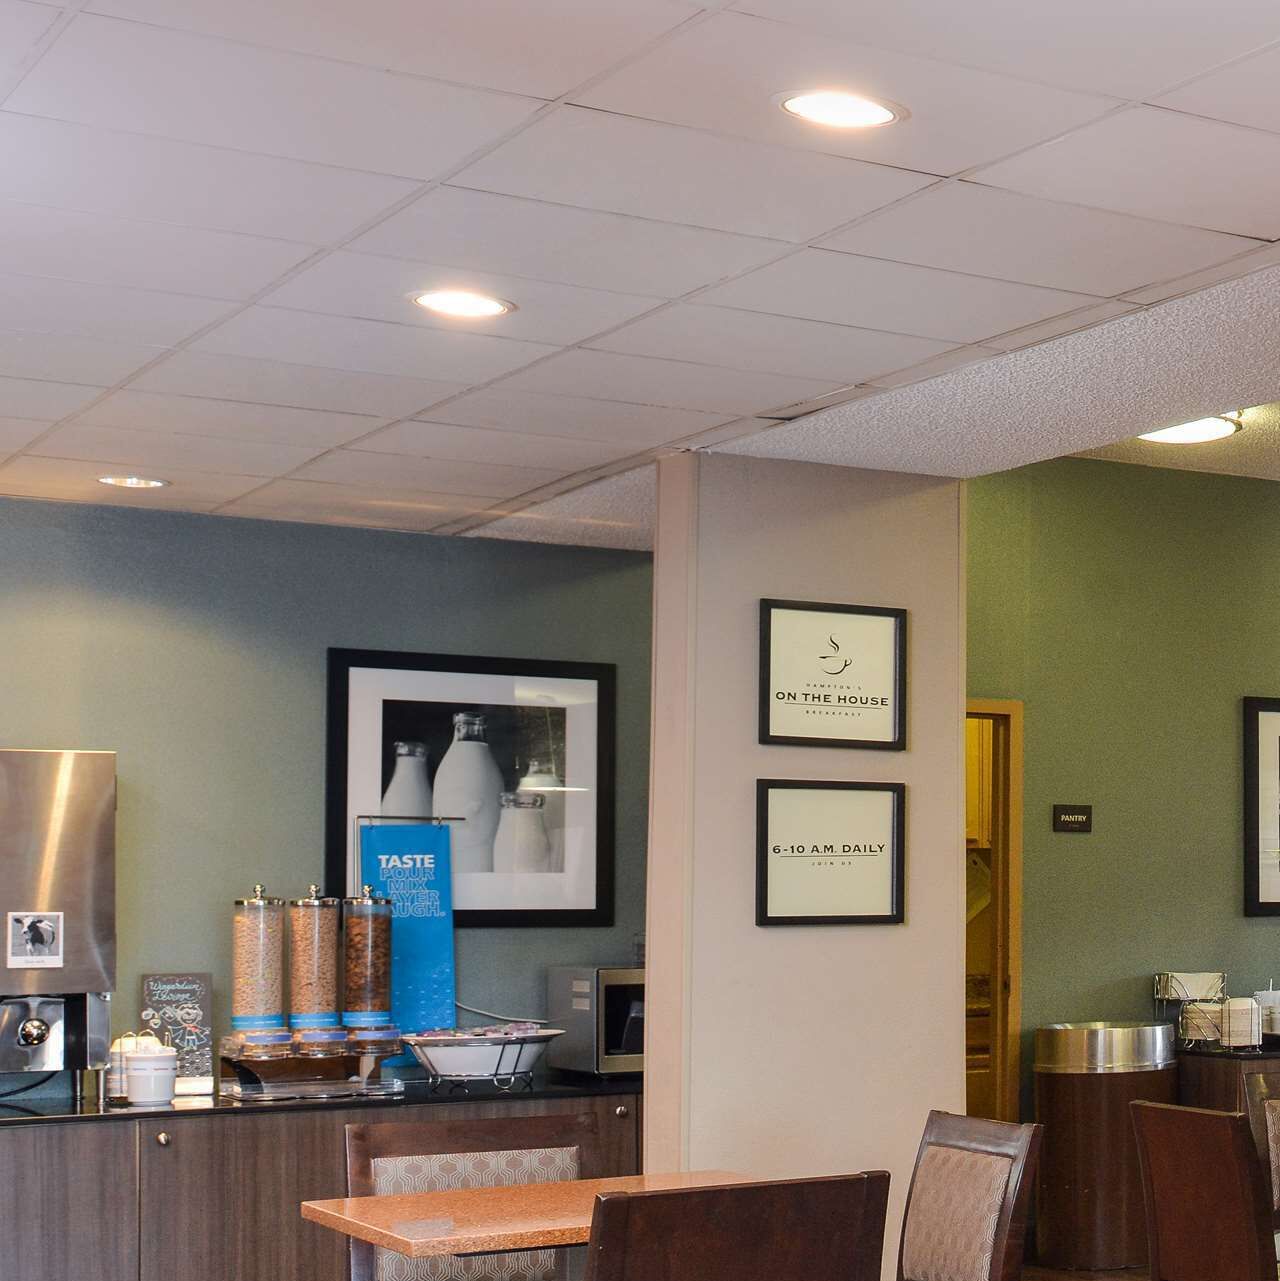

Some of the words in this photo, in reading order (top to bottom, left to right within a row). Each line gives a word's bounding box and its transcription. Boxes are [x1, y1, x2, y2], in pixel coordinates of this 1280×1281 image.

[775, 691, 797, 701] ON
[802, 693, 832, 703] THE
[837, 695, 889, 706] HOUSE
[1061, 814, 1087, 822] PANTRY
[772, 845, 805, 854] 6-10
[811, 845, 838, 854] A.M.
[842, 844, 885, 853] DAILY
[377, 854, 436, 868] TASTE
[380, 867, 436, 880] POUR
[387, 879, 428, 893] MIX
